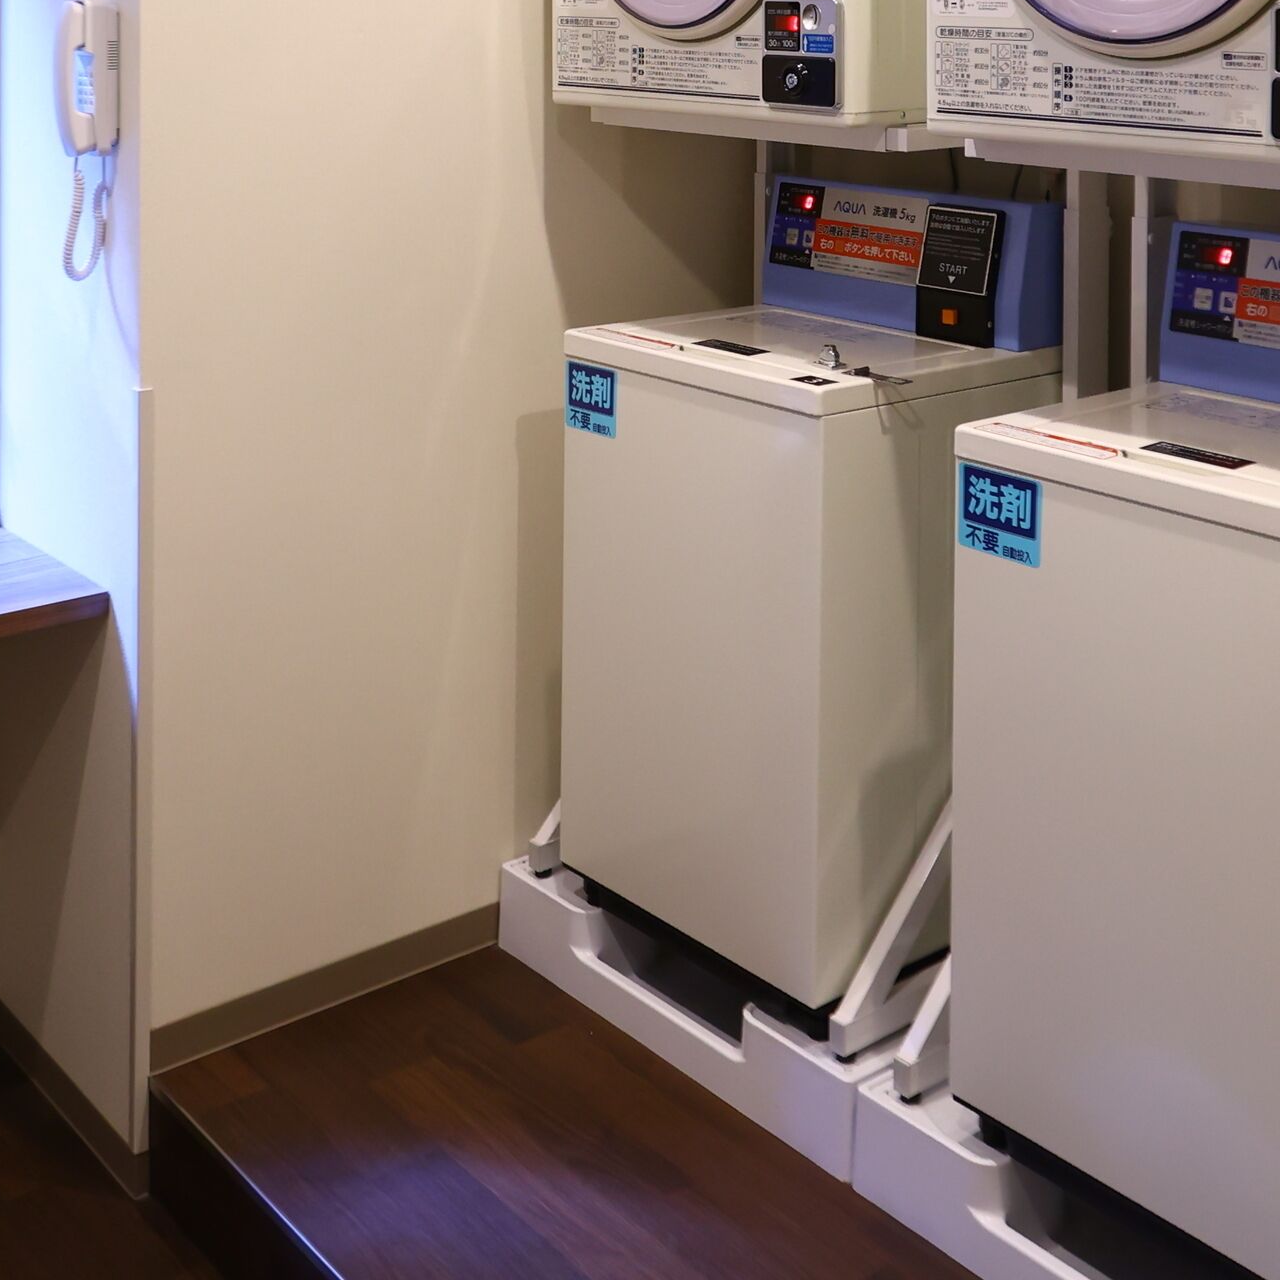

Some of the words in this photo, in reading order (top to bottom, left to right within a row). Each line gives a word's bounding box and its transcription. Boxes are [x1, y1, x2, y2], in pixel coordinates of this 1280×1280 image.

[939, 28, 993, 39] 乾燥時間の目安
[833, 200, 867, 215] AQUA
[872, 205, 898, 219] 洗濯機
[898, 207, 916, 224] 5kg
[819, 238, 835, 250] 右の
[938, 262, 969, 276] START
[1245, 302, 1268, 318] 右の
[571, 368, 611, 410] 洗剤
[569, 408, 592, 431] 不要
[967, 474, 1032, 530] 洗剤
[965, 523, 1000, 555] 不要
